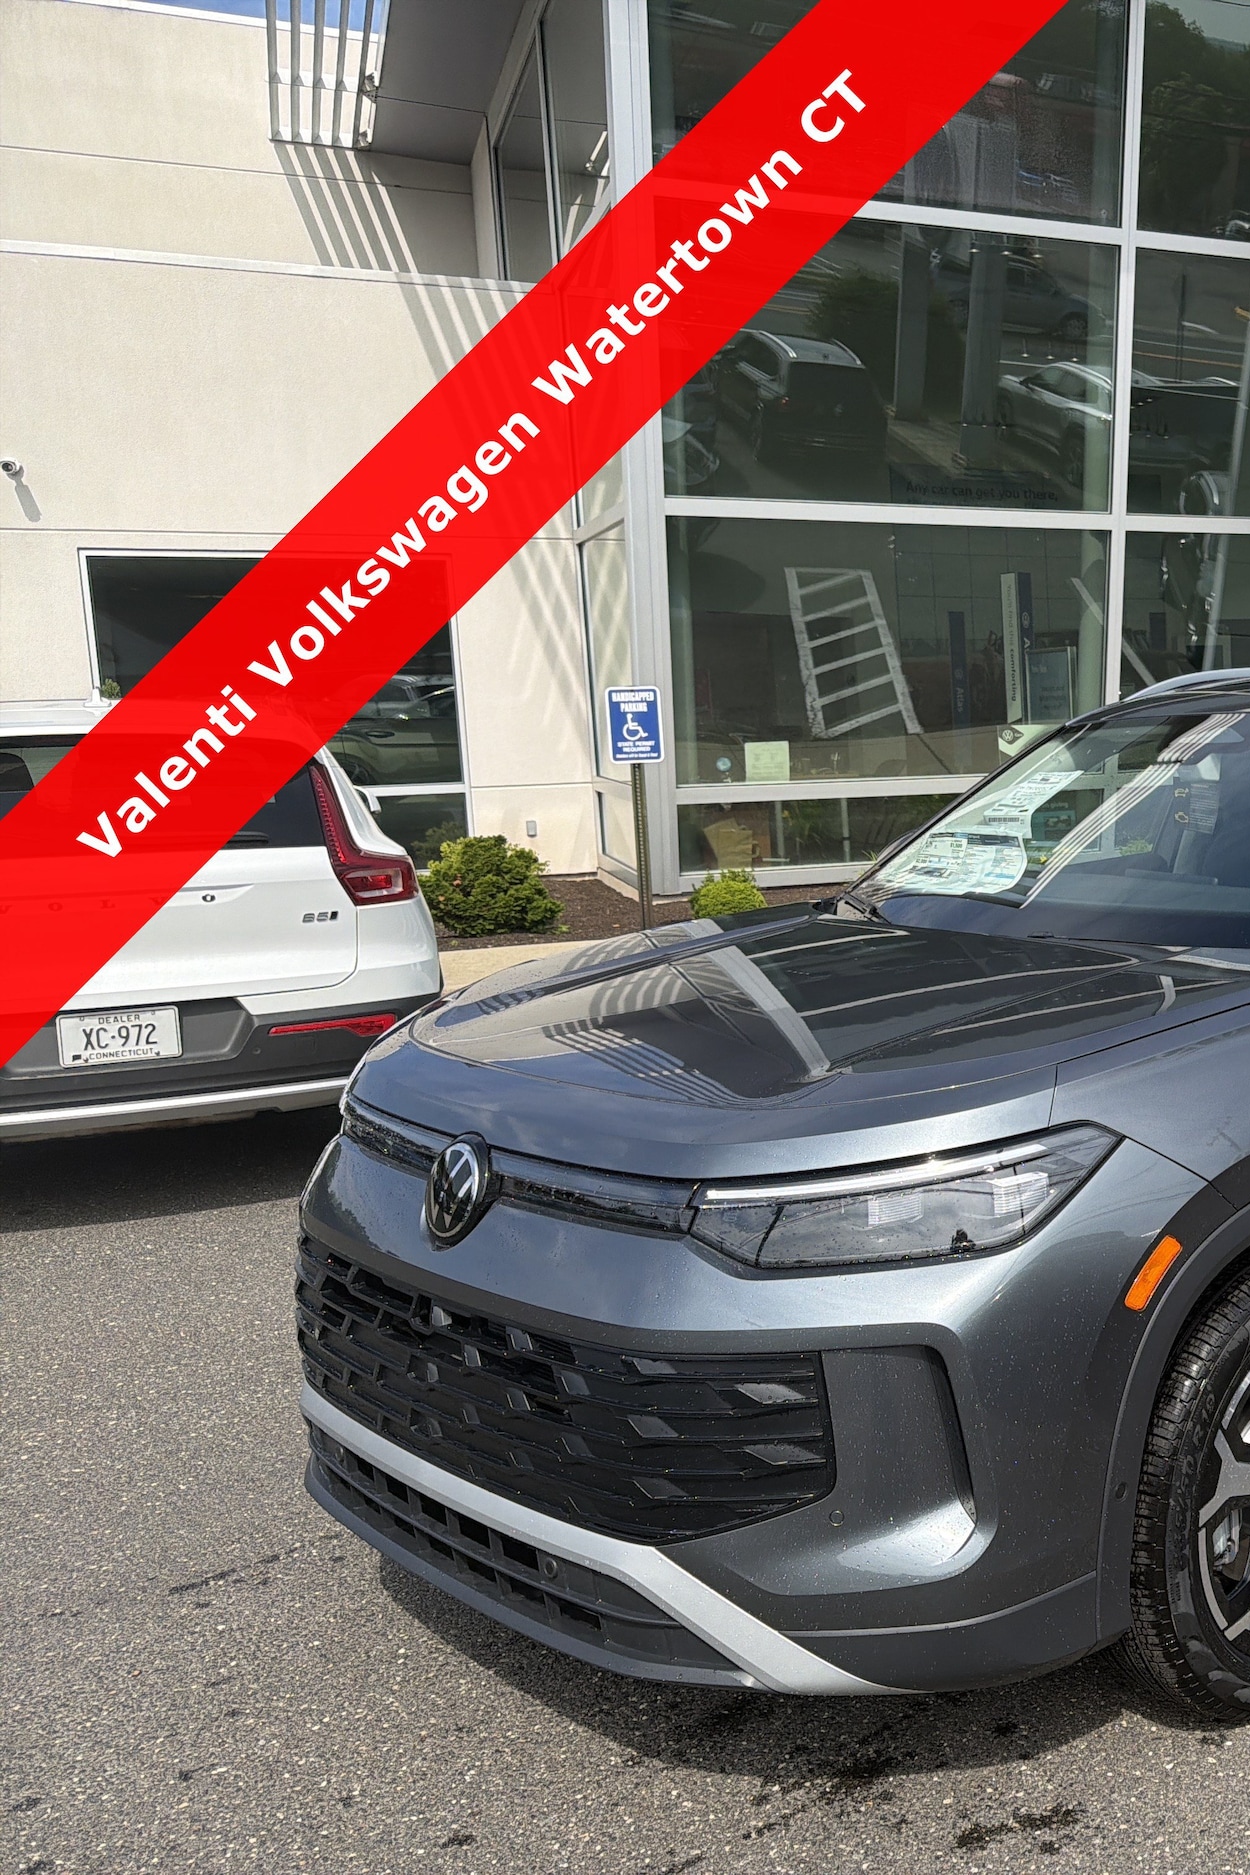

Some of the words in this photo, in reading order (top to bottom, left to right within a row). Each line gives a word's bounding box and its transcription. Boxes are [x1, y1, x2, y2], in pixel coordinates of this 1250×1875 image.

[906, 481, 928, 496] Any
[931, 485, 949, 495] car
[952, 486, 973, 497] can
[976, 487, 995, 500] get
[999, 489, 1020, 501] you
[1023, 487, 1059, 502] there,
[1009, 648, 1018, 702] comforting
[611, 691, 655, 702] HANDICAPPED
[955, 687, 965, 713] Atlas
[620, 702, 648, 712] PARKING
[98, 1014, 141, 1025] DEALER
[88, 1047, 154, 1060] CONNECTICUT
